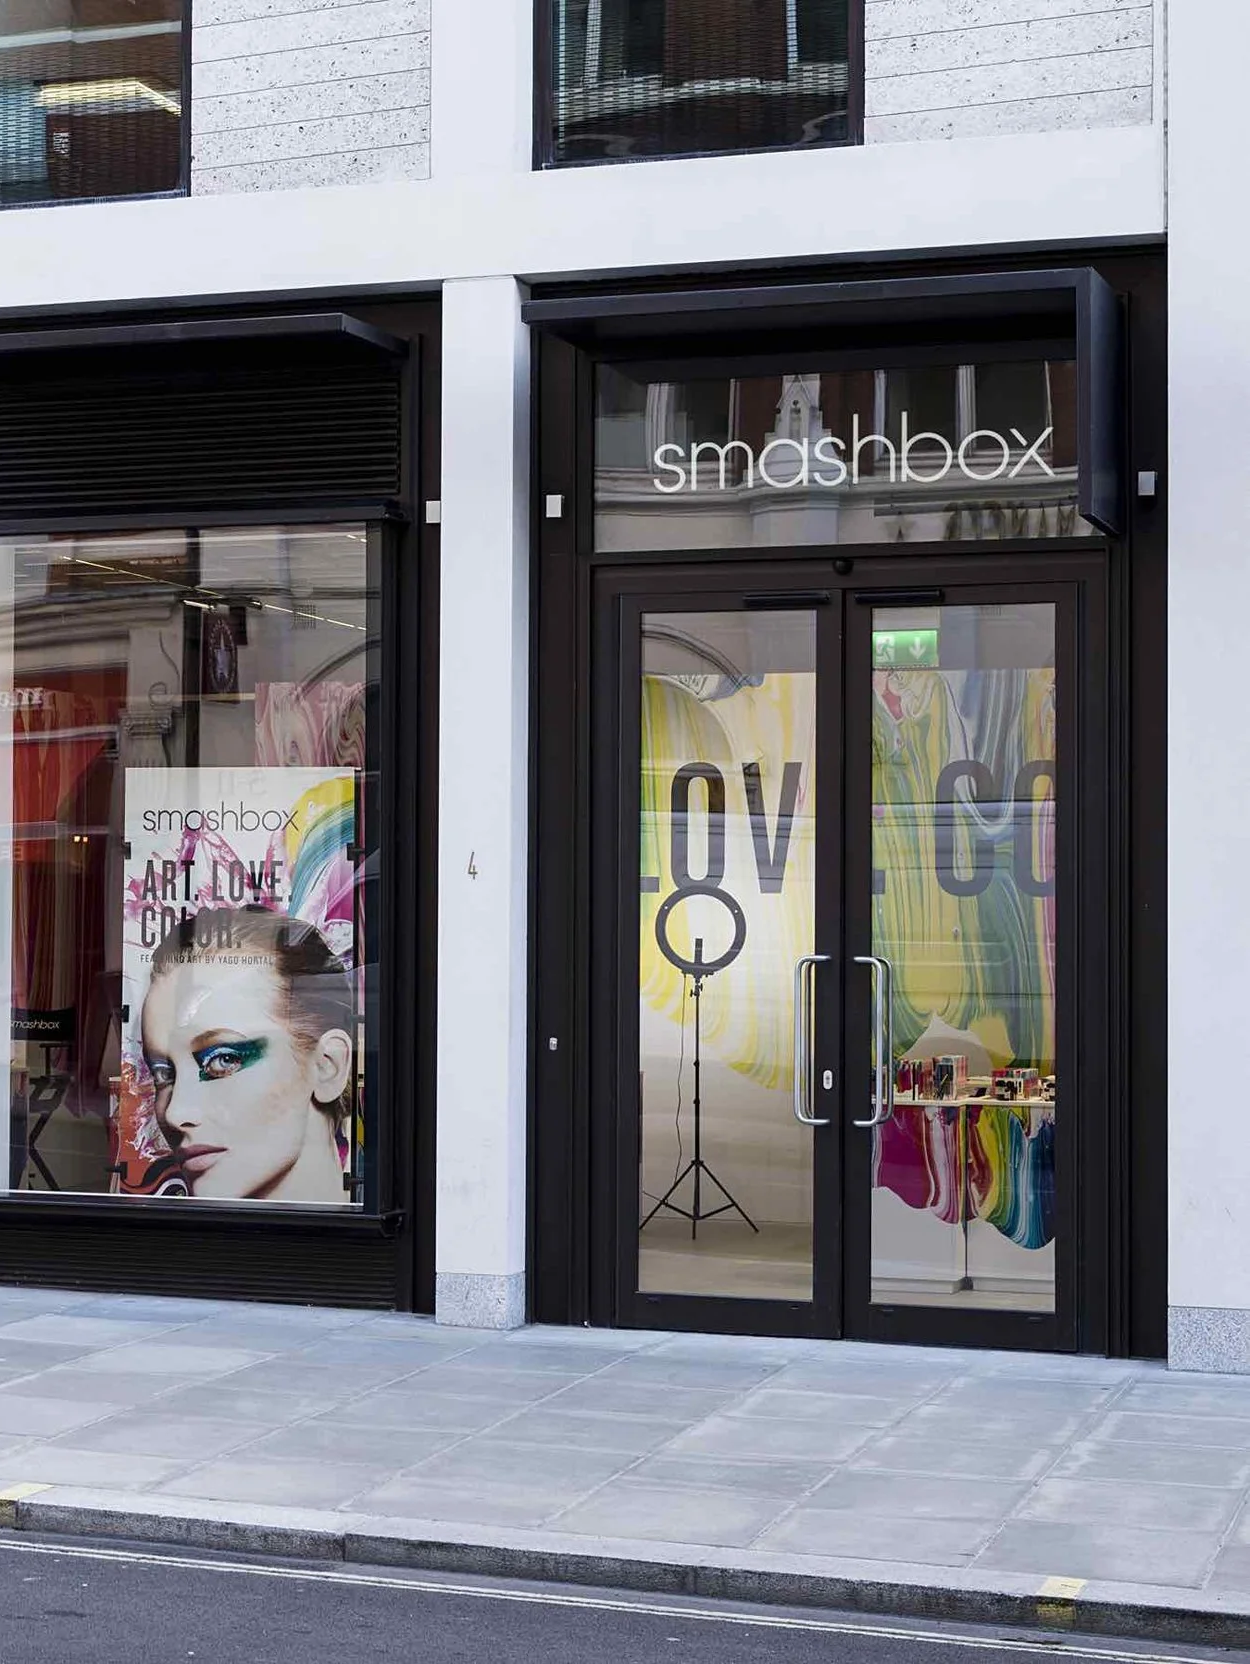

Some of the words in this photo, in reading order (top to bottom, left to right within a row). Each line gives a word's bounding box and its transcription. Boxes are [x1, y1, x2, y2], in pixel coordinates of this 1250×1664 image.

[653, 411, 1055, 493] smashbox
[143, 801, 299, 832] smashbox
[142, 860, 199, 901] ART.
[212, 860, 293, 902] LOVE.
[468, 851, 478, 880] 4
